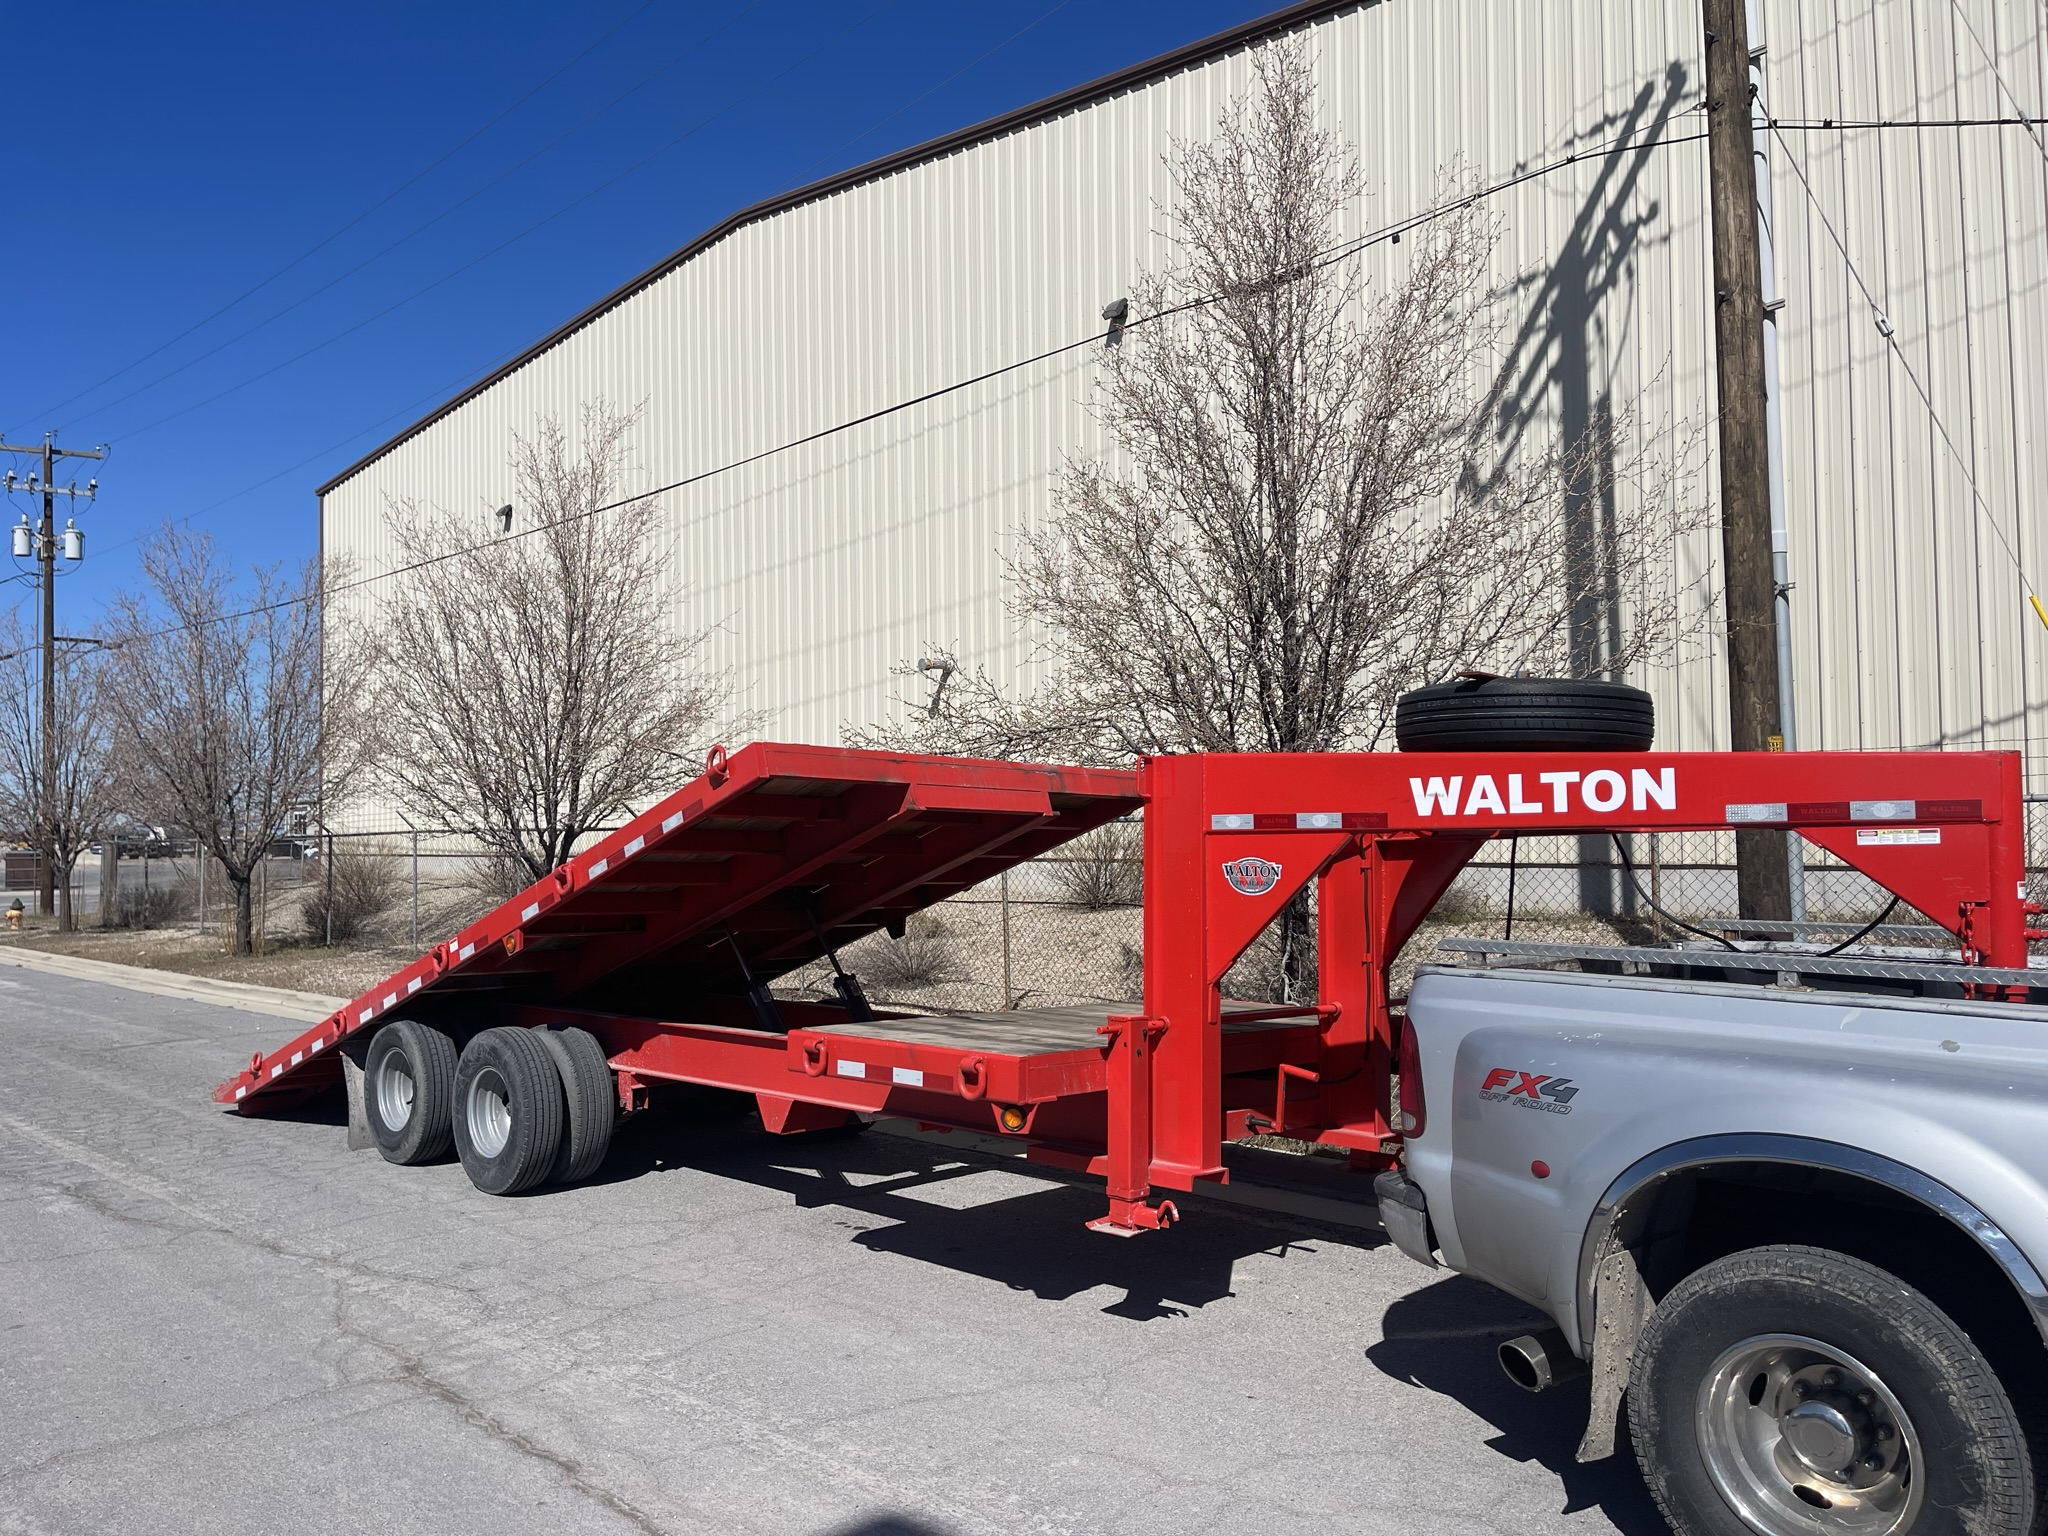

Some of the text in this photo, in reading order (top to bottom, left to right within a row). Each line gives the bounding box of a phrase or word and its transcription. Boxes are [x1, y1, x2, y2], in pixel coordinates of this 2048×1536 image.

[1408, 767, 1677, 817] WALTON
[1224, 865, 1280, 878] WALTON
[1481, 1067, 1580, 1104] FX4
[1479, 1090, 1573, 1115] OFF ROAD
